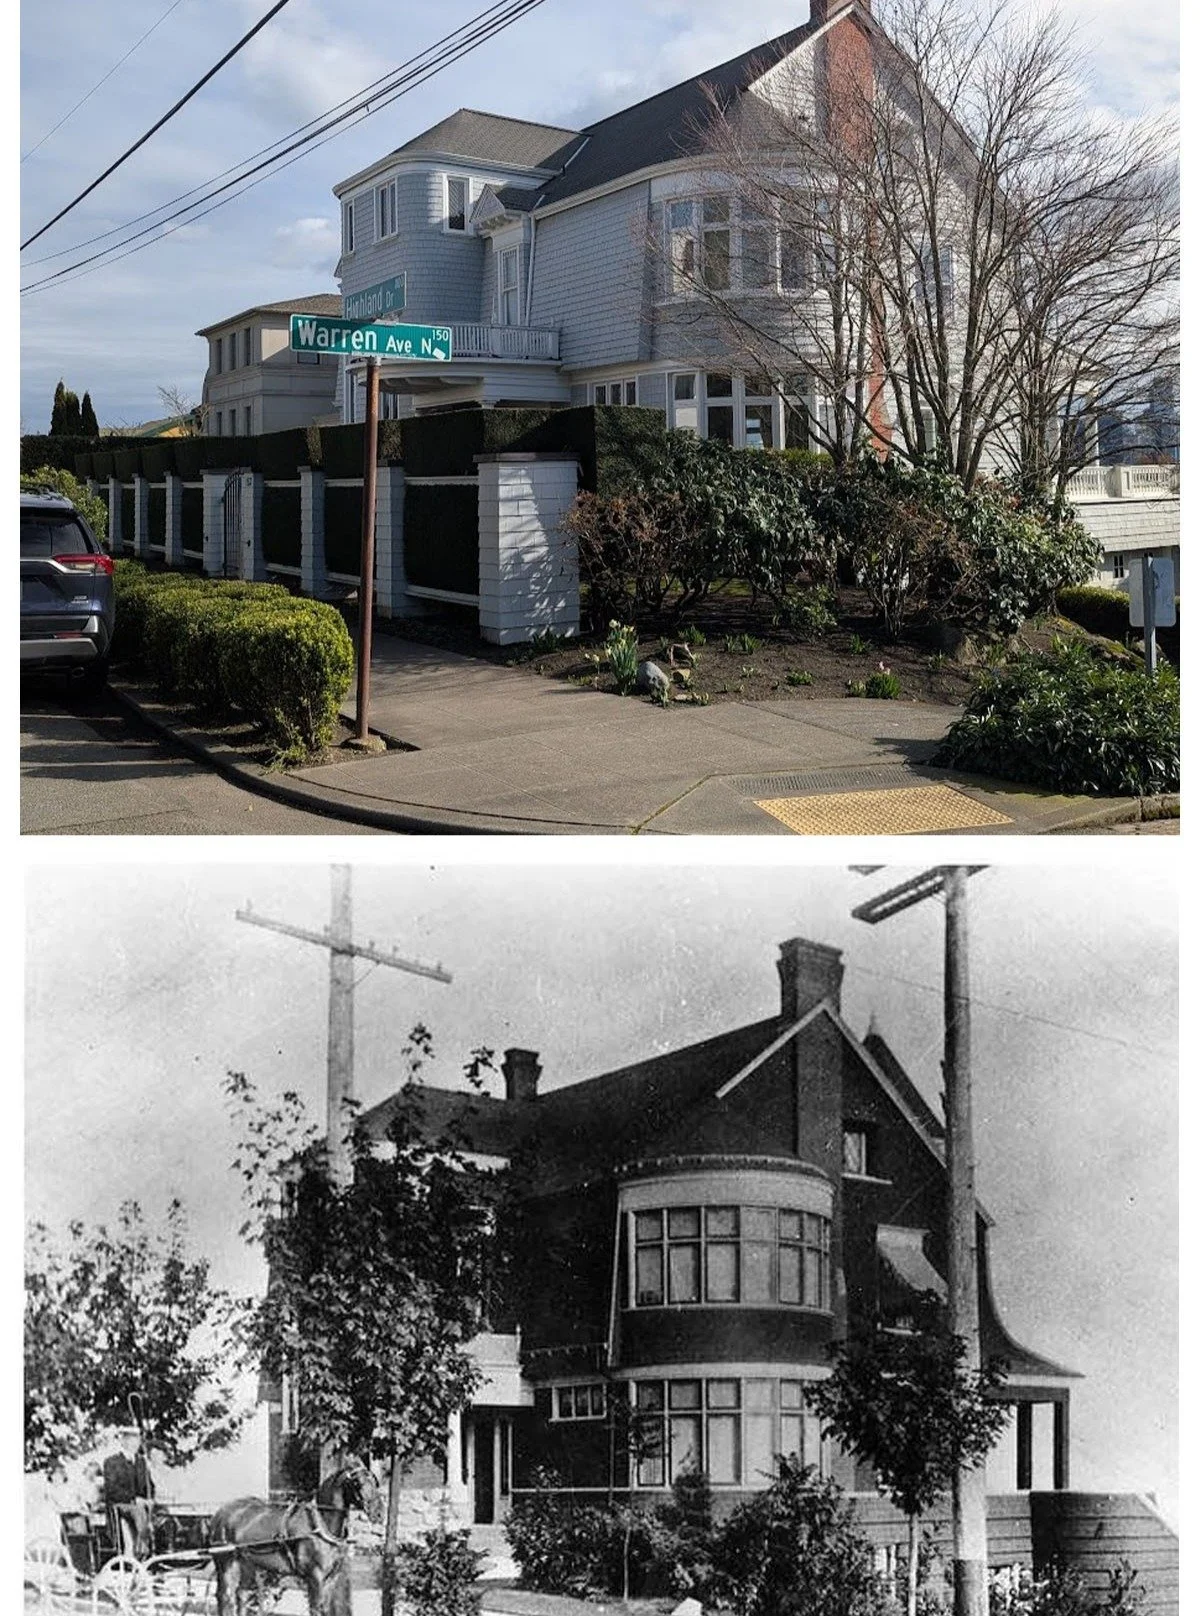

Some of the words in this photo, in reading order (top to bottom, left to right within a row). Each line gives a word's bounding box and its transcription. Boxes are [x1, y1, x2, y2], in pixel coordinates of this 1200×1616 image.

[297, 319, 378, 351] Warren
[386, 335, 413, 353] Ave
[421, 337, 431, 355] N
[432, 329, 449, 342] 150
